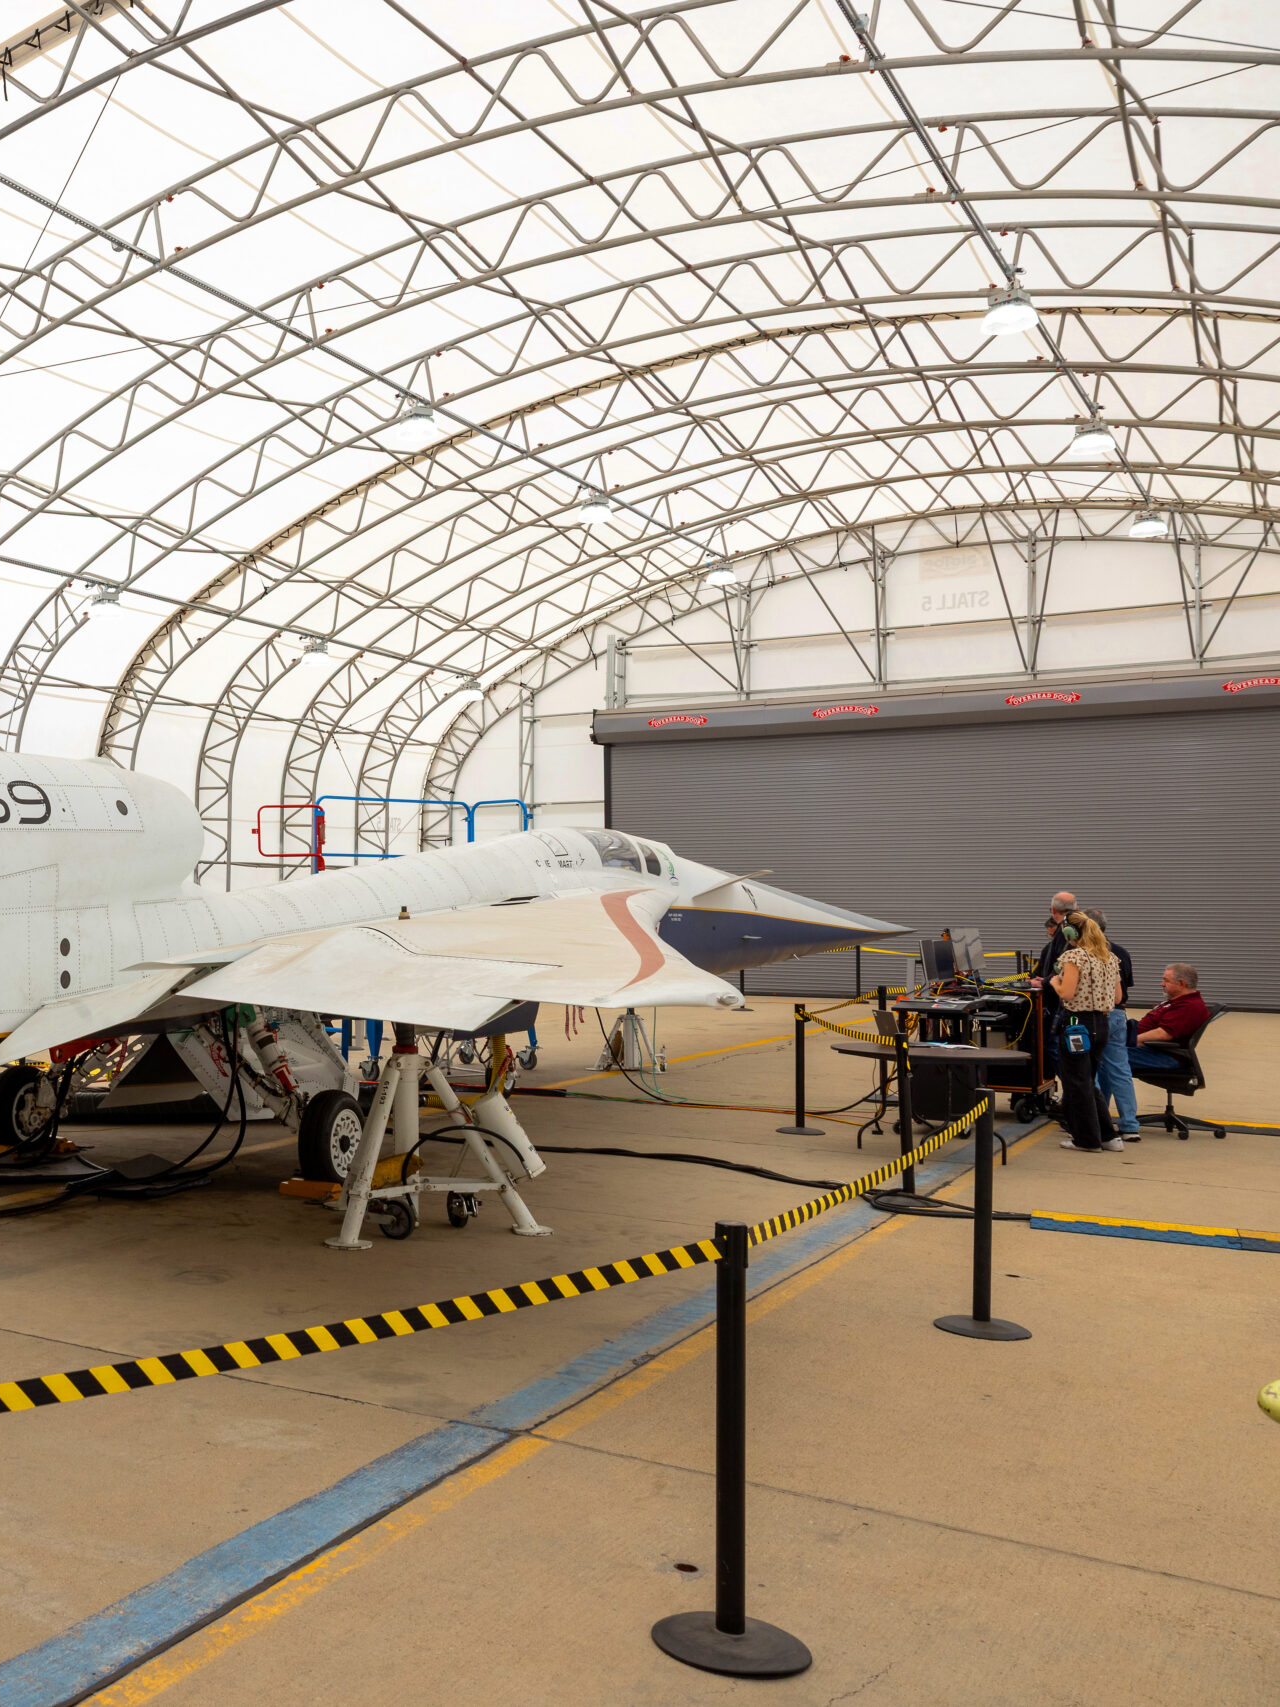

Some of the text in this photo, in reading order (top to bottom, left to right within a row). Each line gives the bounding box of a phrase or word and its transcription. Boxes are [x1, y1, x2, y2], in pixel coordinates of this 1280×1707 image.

[1231, 678, 1276, 691] OVERHEAD
[1013, 692, 1073, 705] OVERHEAD DOOR
[819, 705, 872, 718] OVERHEAD DOOR
[654, 715, 701, 727] OVERHEAD DOOR
